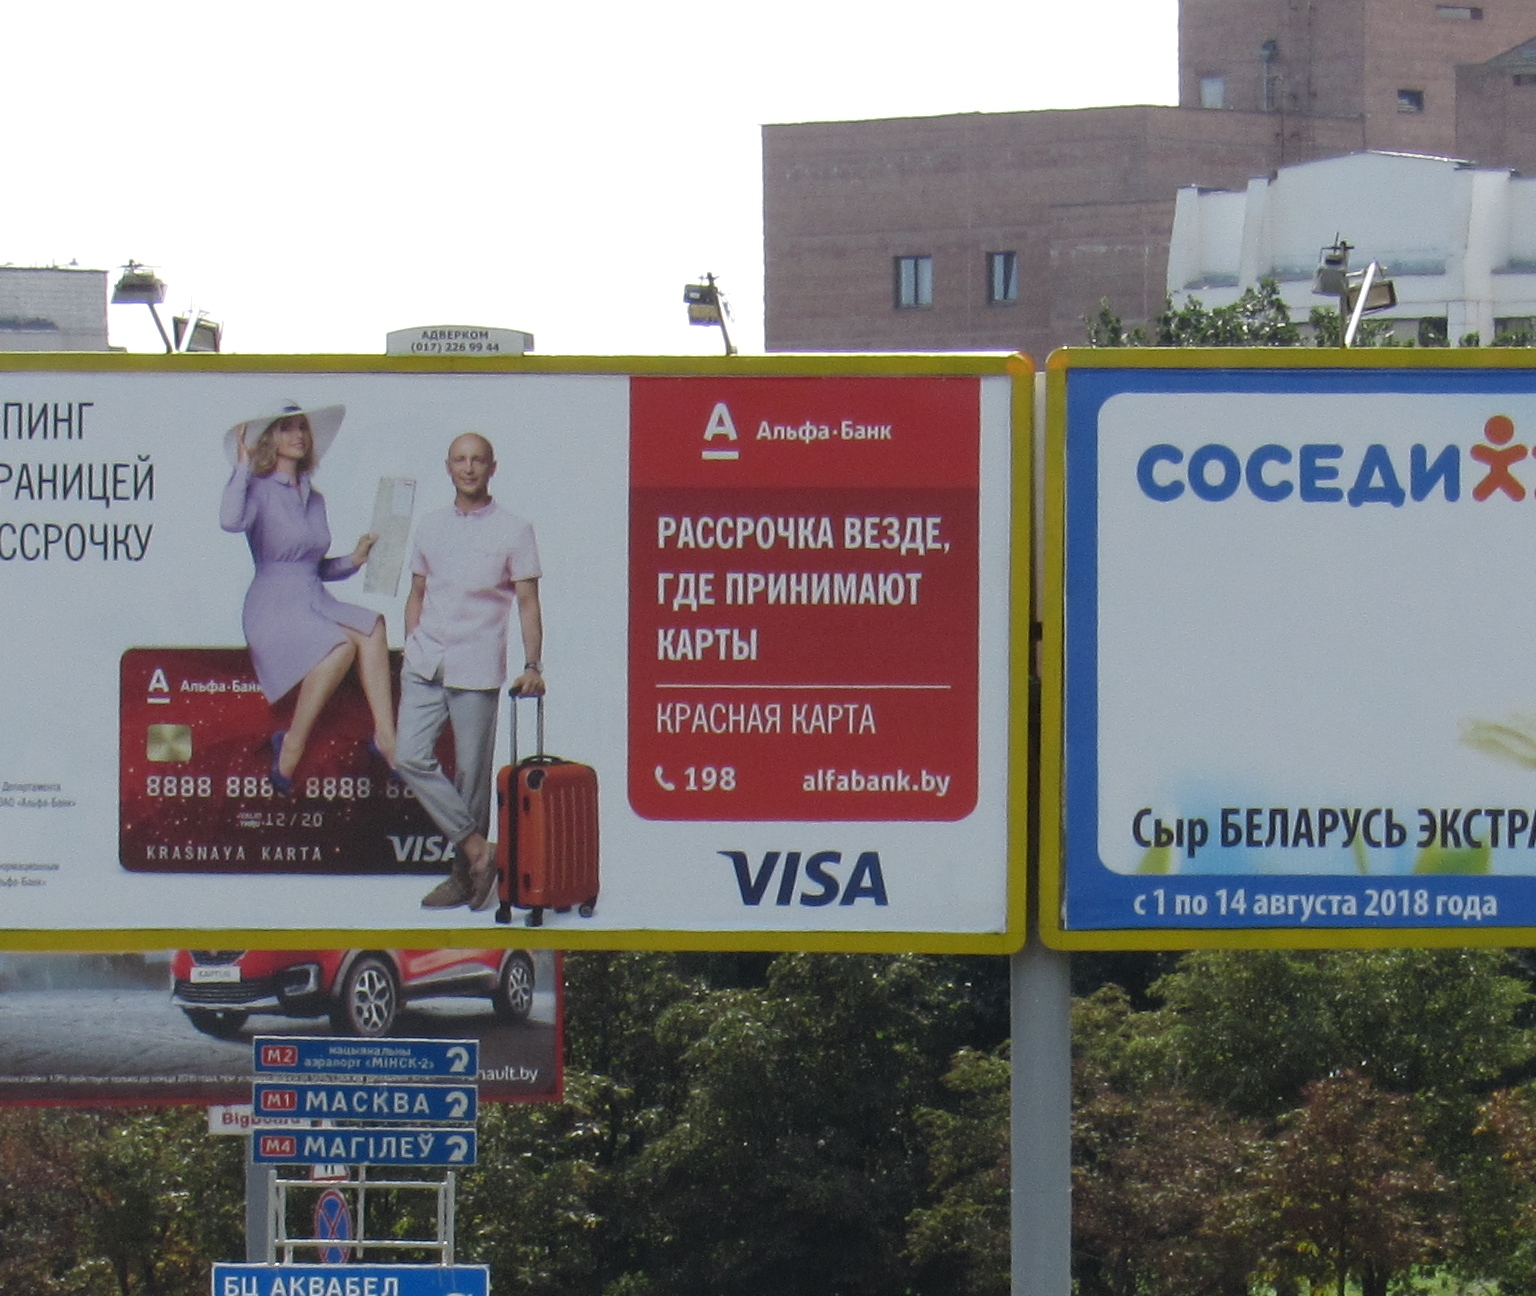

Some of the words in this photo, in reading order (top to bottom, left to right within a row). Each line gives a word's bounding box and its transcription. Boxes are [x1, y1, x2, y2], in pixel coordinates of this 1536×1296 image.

[411, 343, 442, 353] (017)
[446, 343, 466, 352] 226
[469, 343, 483, 351] 99
[486, 343, 499, 351] 44
[421, 331, 489, 340] АДВЕРКОМ
[1137, 443, 1460, 508] СОСЕДИ
[658, 516, 834, 550] РАССРОЧКА
[844, 517, 951, 556] ВЕЗДЕ,
[658, 573, 715, 611] ГДЕ
[726, 573, 921, 605] ПРИНИМАЮТ
[658, 628, 758, 661] КАРТЫ
[657, 703, 781, 734] КРАСНАЯ
[792, 703, 876, 735] КАРТА
[146, 776, 211, 797] 8888
[226, 776, 285, 797] 888
[306, 777, 370, 798] 8888
[684, 767, 736, 792] 198
[803, 766, 950, 797] alfabank.by
[1133, 808, 1208, 858] Сыр
[1221, 808, 1406, 849] БЕЛАРУСЬ
[146, 846, 246, 861] KRASNAYA
[262, 846, 322, 861] KARTA
[717, 850, 890, 907] VISA
[1134, 894, 1147, 915] с
[1152, 890, 1166, 914] 1
[1175, 895, 1207, 915] по
[1215, 890, 1246, 914] 14
[1253, 895, 1357, 922] августа
[1365, 890, 1428, 916] 2018
[1435, 896, 1497, 919] года
[305, 1091, 430, 1113] МАСКВА
[304, 1133, 434, 1157] МАГІЛЕЎ
